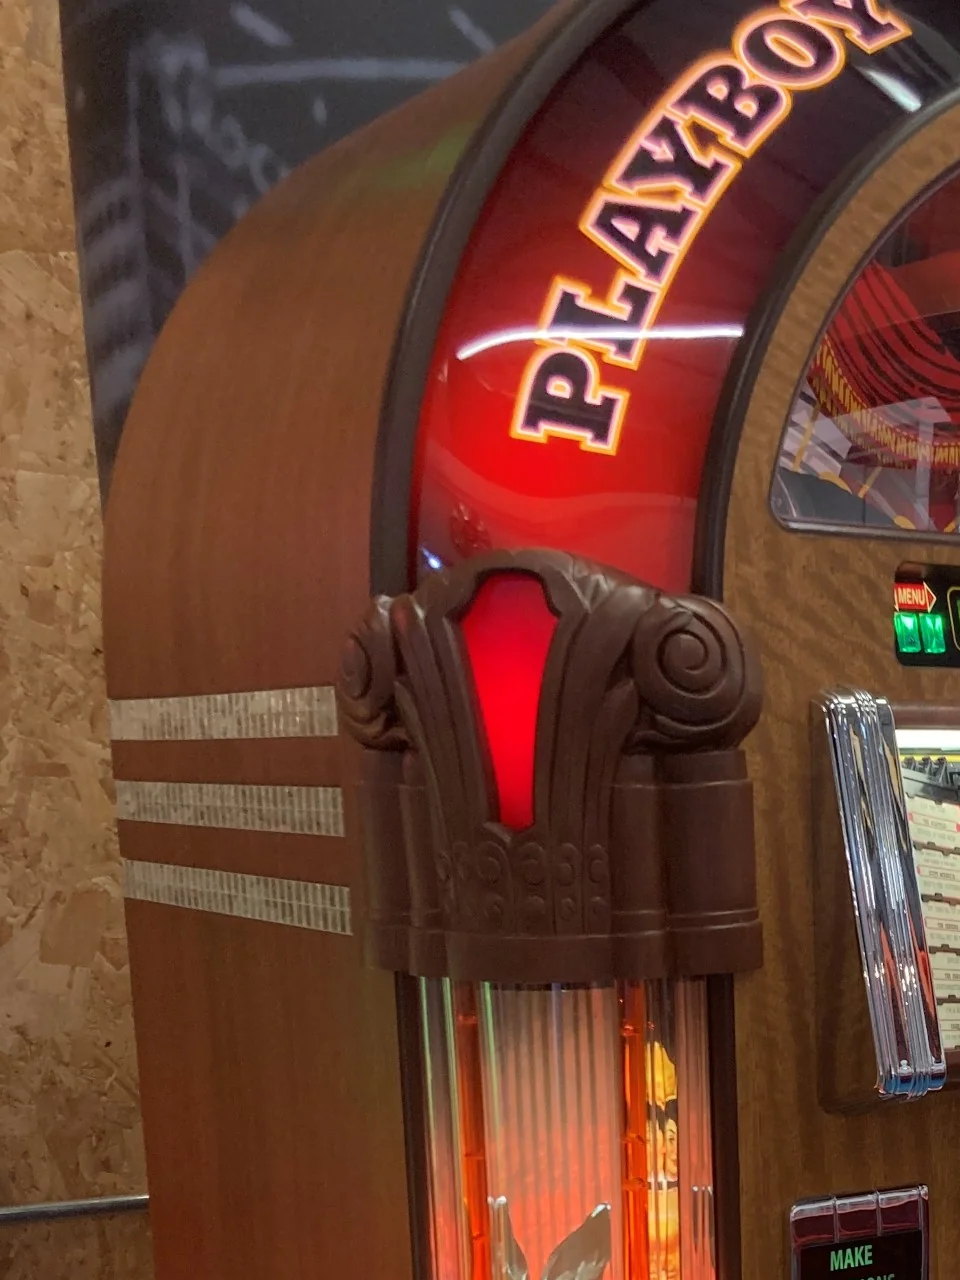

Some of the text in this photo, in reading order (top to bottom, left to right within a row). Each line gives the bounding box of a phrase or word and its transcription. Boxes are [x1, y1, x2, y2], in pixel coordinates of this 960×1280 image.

[510, 0, 912, 456] PLAYBOY
[897, 589, 926, 605] MENU
[830, 1244, 873, 1272] MAKE
